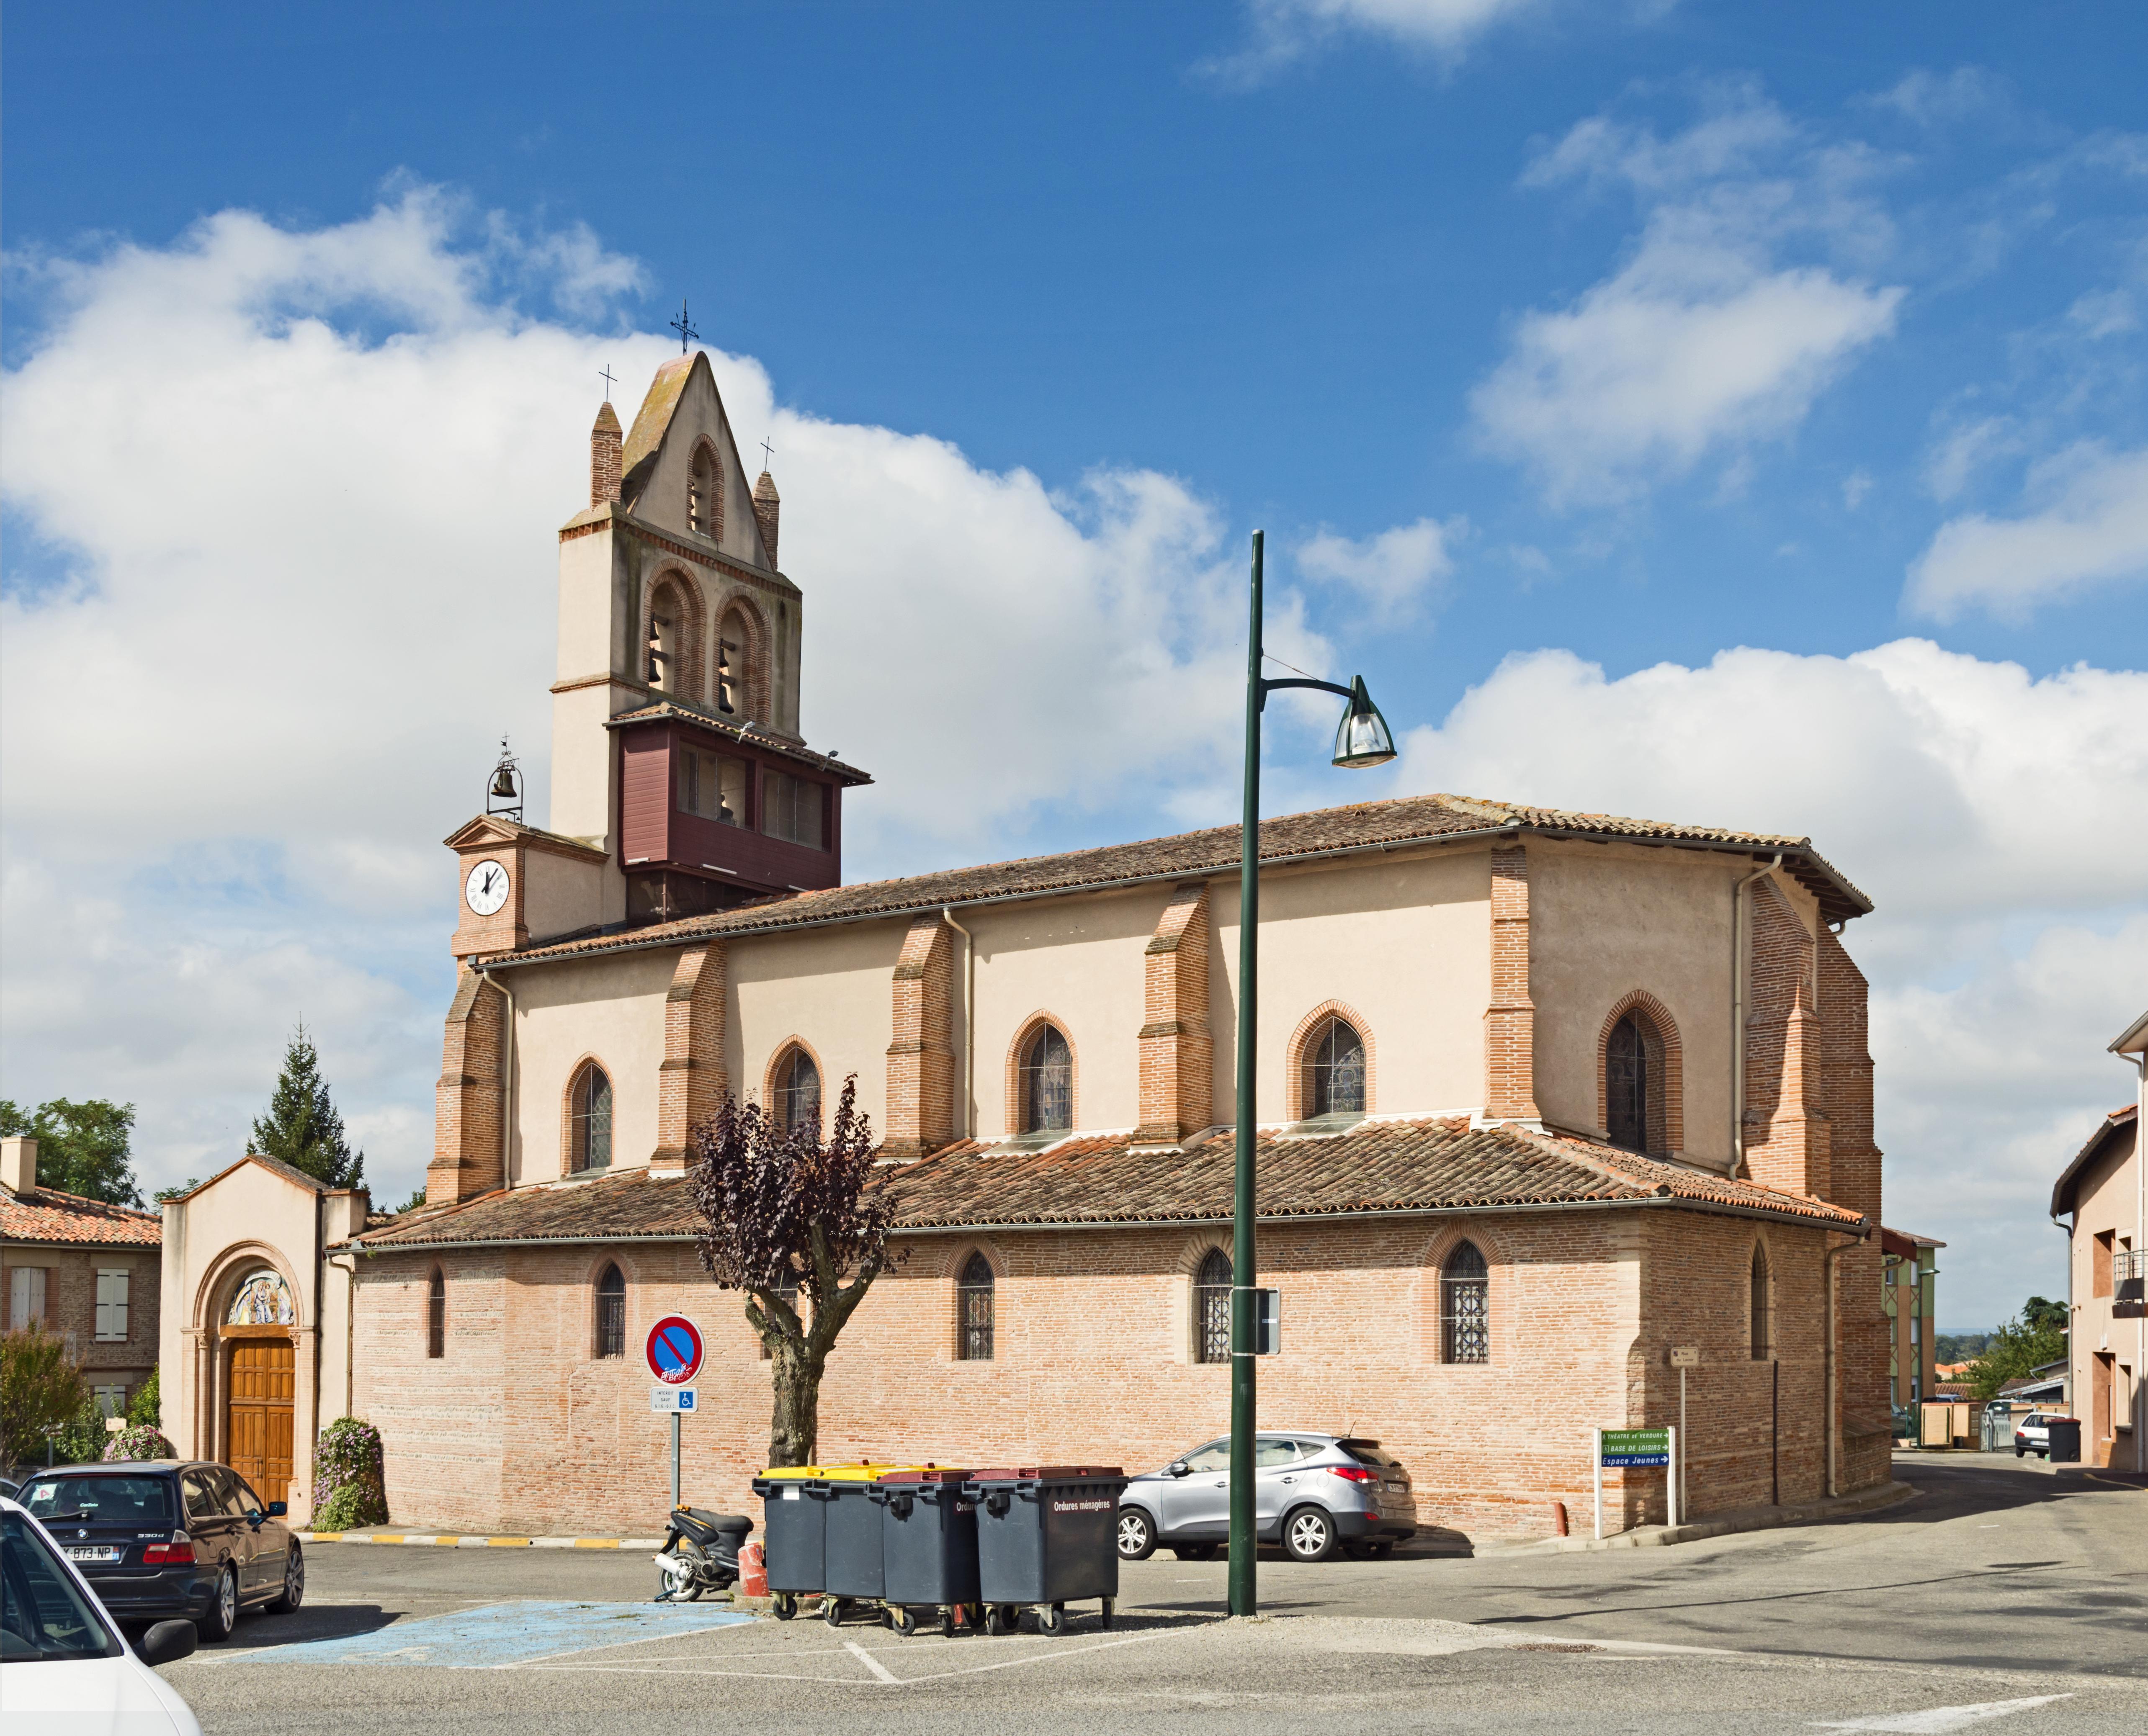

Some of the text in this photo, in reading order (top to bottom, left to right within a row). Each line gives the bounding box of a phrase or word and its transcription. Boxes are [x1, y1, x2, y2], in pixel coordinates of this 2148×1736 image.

[1602, 1458, 1628, 1466] Espace
[40, 1489, 50, 1499] A
[1054, 1499, 1110, 1512] Ordures ménagères
